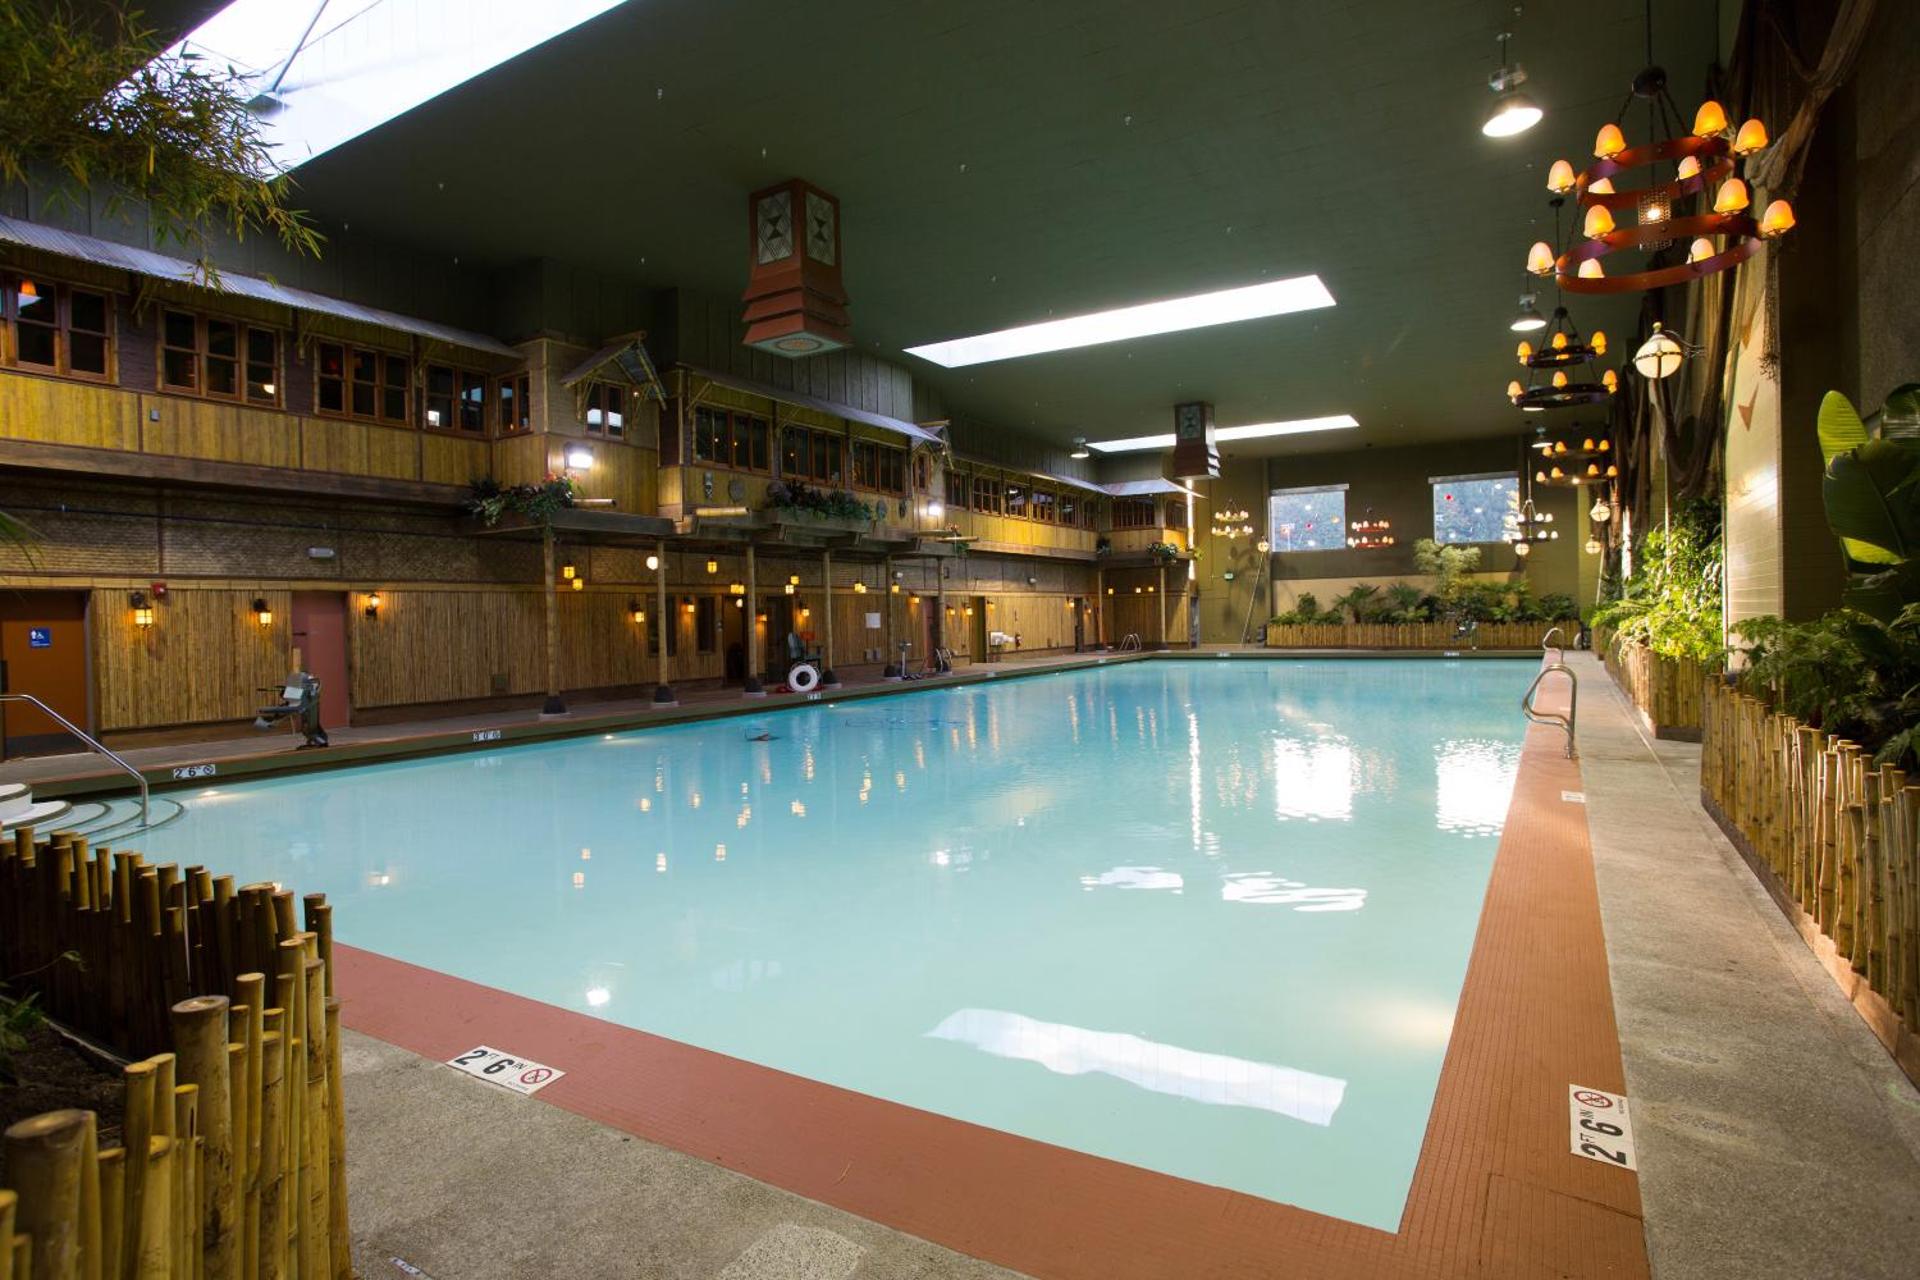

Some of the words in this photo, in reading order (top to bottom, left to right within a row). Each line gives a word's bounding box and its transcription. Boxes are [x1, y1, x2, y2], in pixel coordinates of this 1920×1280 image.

[175, 768, 182, 778] 2
[188, 767, 197, 777] 6
[454, 1050, 488, 1065] 2
[483, 1059, 515, 1074] 6
[1580, 1109, 1594, 1119] IN
[1580, 1119, 1623, 1136] 6
[1580, 1132, 1595, 1144] FT
[1581, 1143, 1627, 1165] 2
